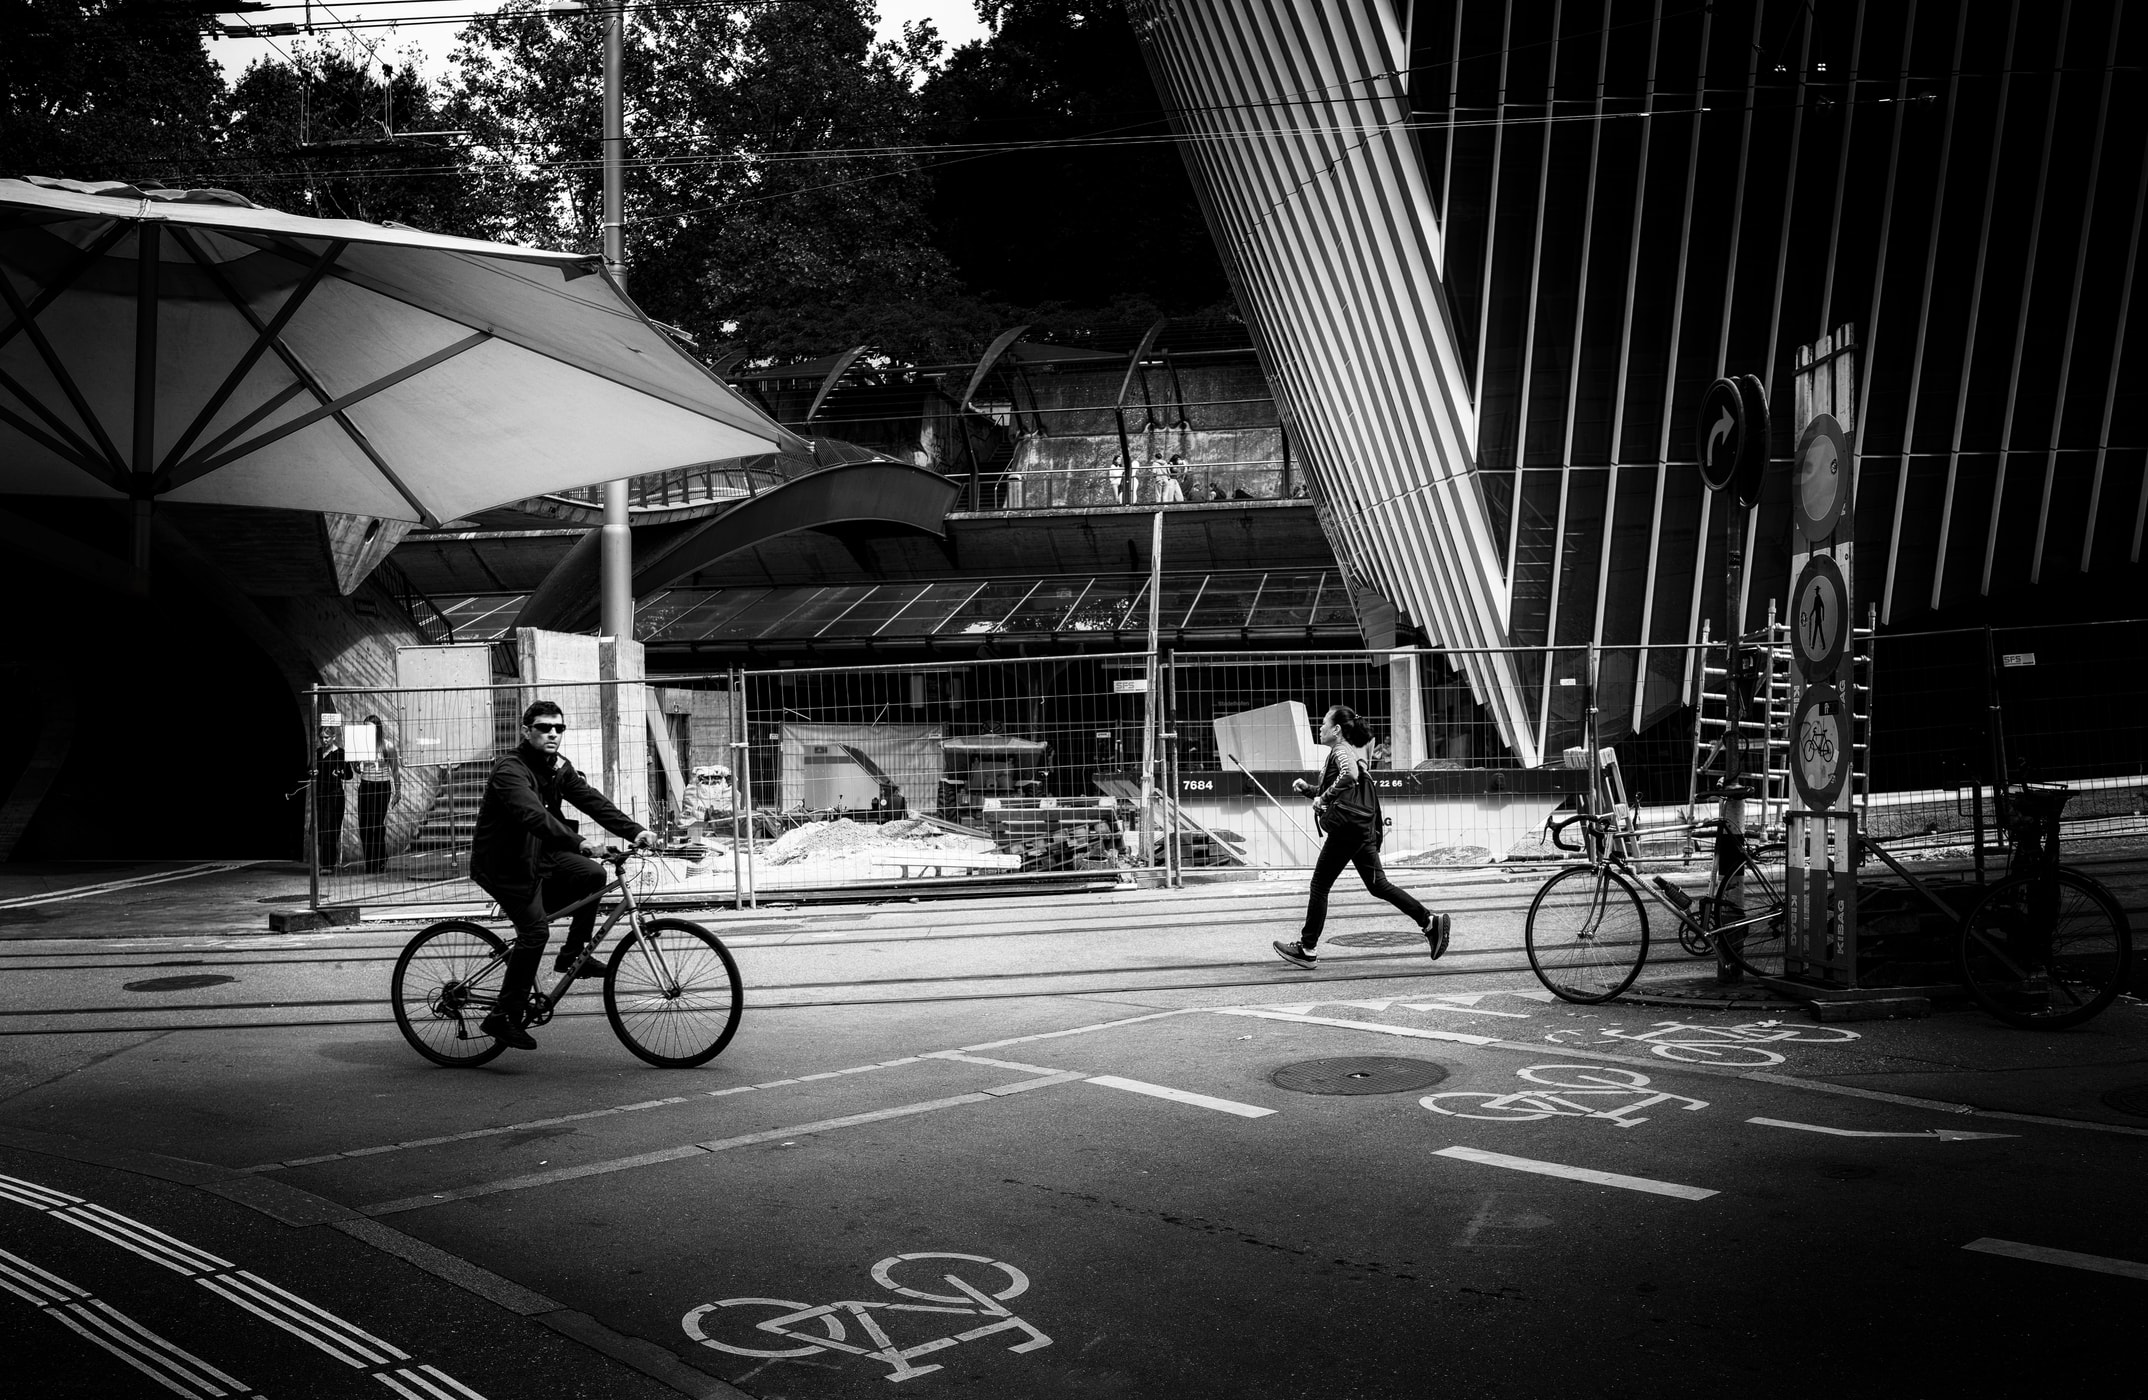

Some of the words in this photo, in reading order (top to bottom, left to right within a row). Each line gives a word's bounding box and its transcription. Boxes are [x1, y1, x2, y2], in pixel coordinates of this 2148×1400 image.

[2004, 655, 2022, 664] SFS
[1115, 681, 1135, 689] SFS
[1182, 780, 1213, 791] 7684
[1391, 779, 1403, 787] 66
[1790, 894, 1798, 947] KIBAG
[1837, 899, 1845, 955] KIBAG
